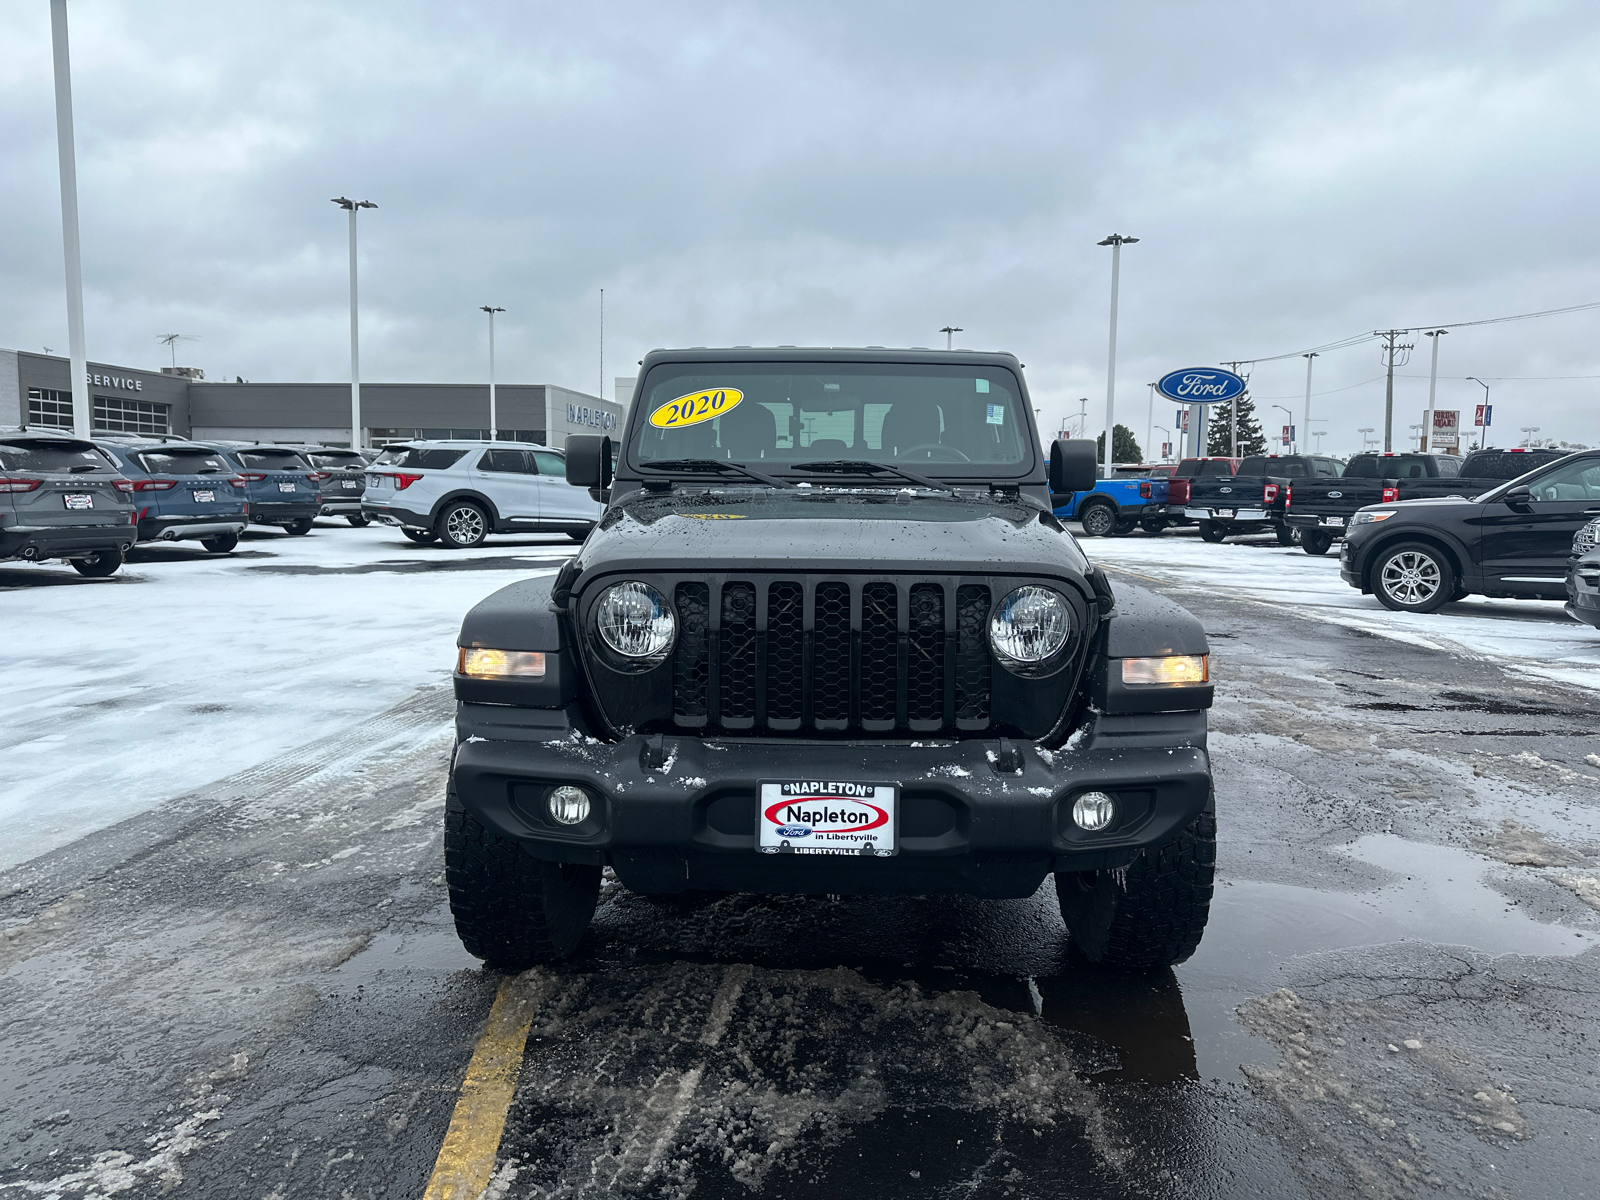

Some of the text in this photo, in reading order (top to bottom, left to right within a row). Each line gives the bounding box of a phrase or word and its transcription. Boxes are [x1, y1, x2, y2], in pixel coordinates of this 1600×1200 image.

[86, 373, 142, 391] SERVICE
[1177, 374, 1229, 396] Ford
[567, 403, 617, 430] NAPLETON
[666, 390, 726, 425] 2020
[790, 782, 866, 796] NAPLETON
[787, 805, 869, 827] Napleton
[783, 826, 806, 836] Ford
[815, 832, 878, 843] in Libertyville
[794, 847, 860, 855] LIBERTYVILLE
